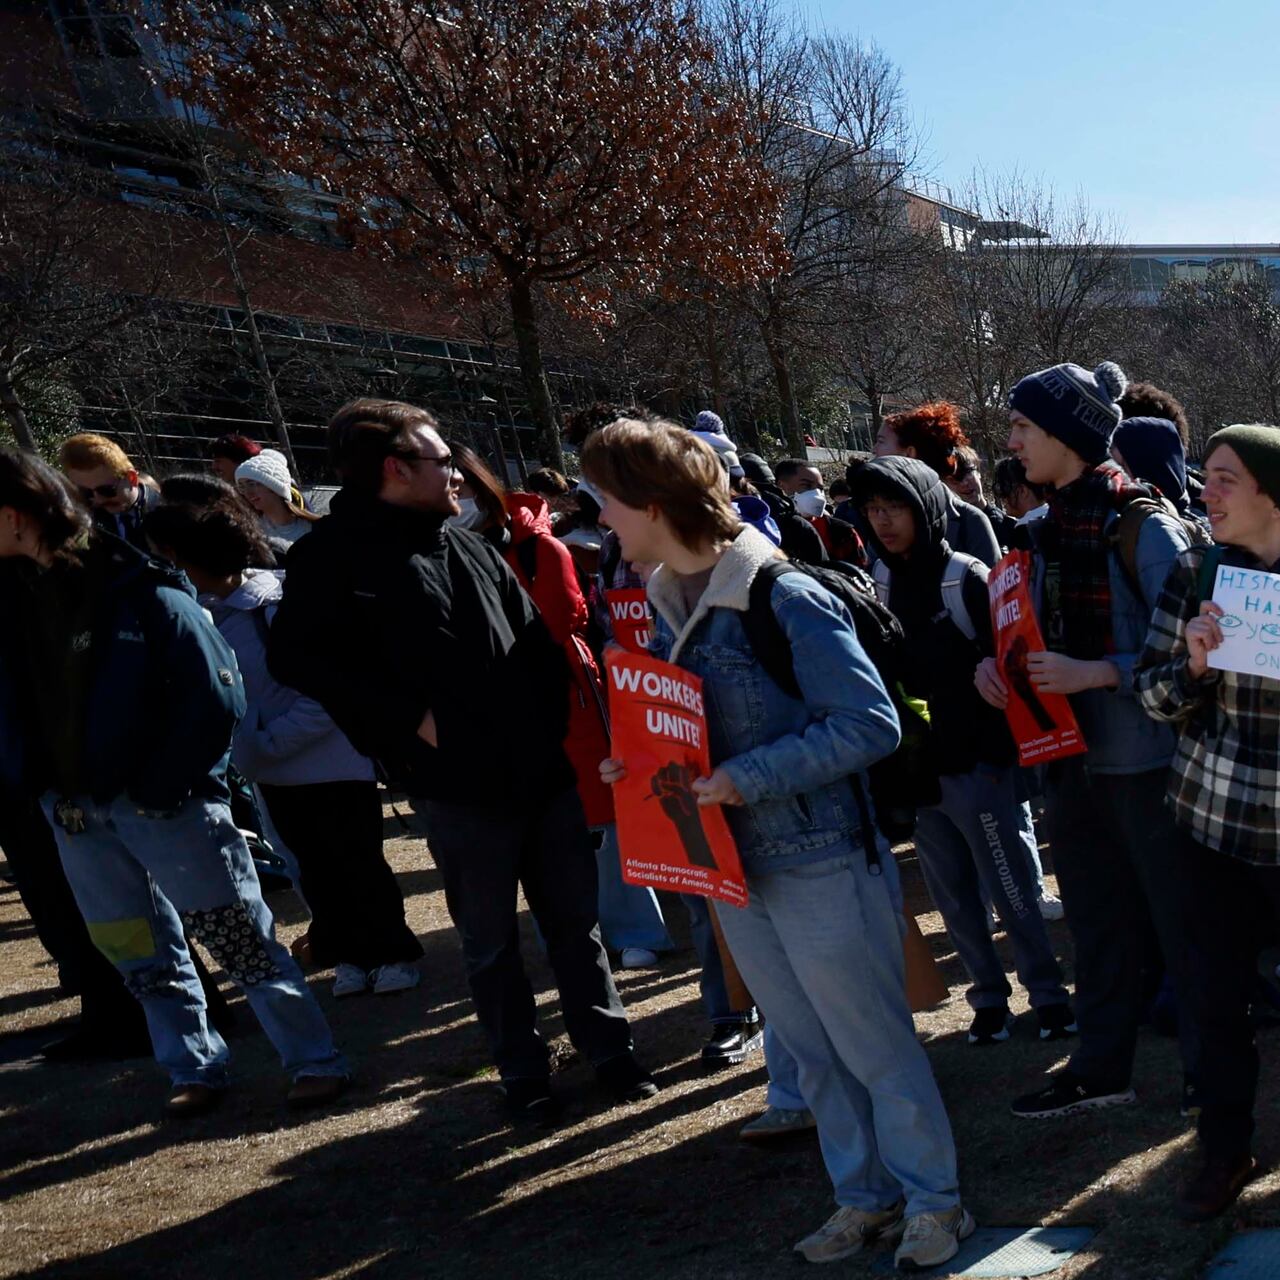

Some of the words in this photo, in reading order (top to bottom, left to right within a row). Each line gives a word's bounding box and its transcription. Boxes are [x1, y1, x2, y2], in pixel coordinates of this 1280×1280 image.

[1255, 652, 1280, 670] ON
[611, 665, 704, 716] WORKERS
[626, 858, 658, 871] Atlanta
[660, 863, 708, 879] Democratic
[980, 812, 1024, 912] abercrombie
[627, 869, 667, 882] Socialists
[669, 875, 680, 883] of
[681, 877, 714, 890] America
